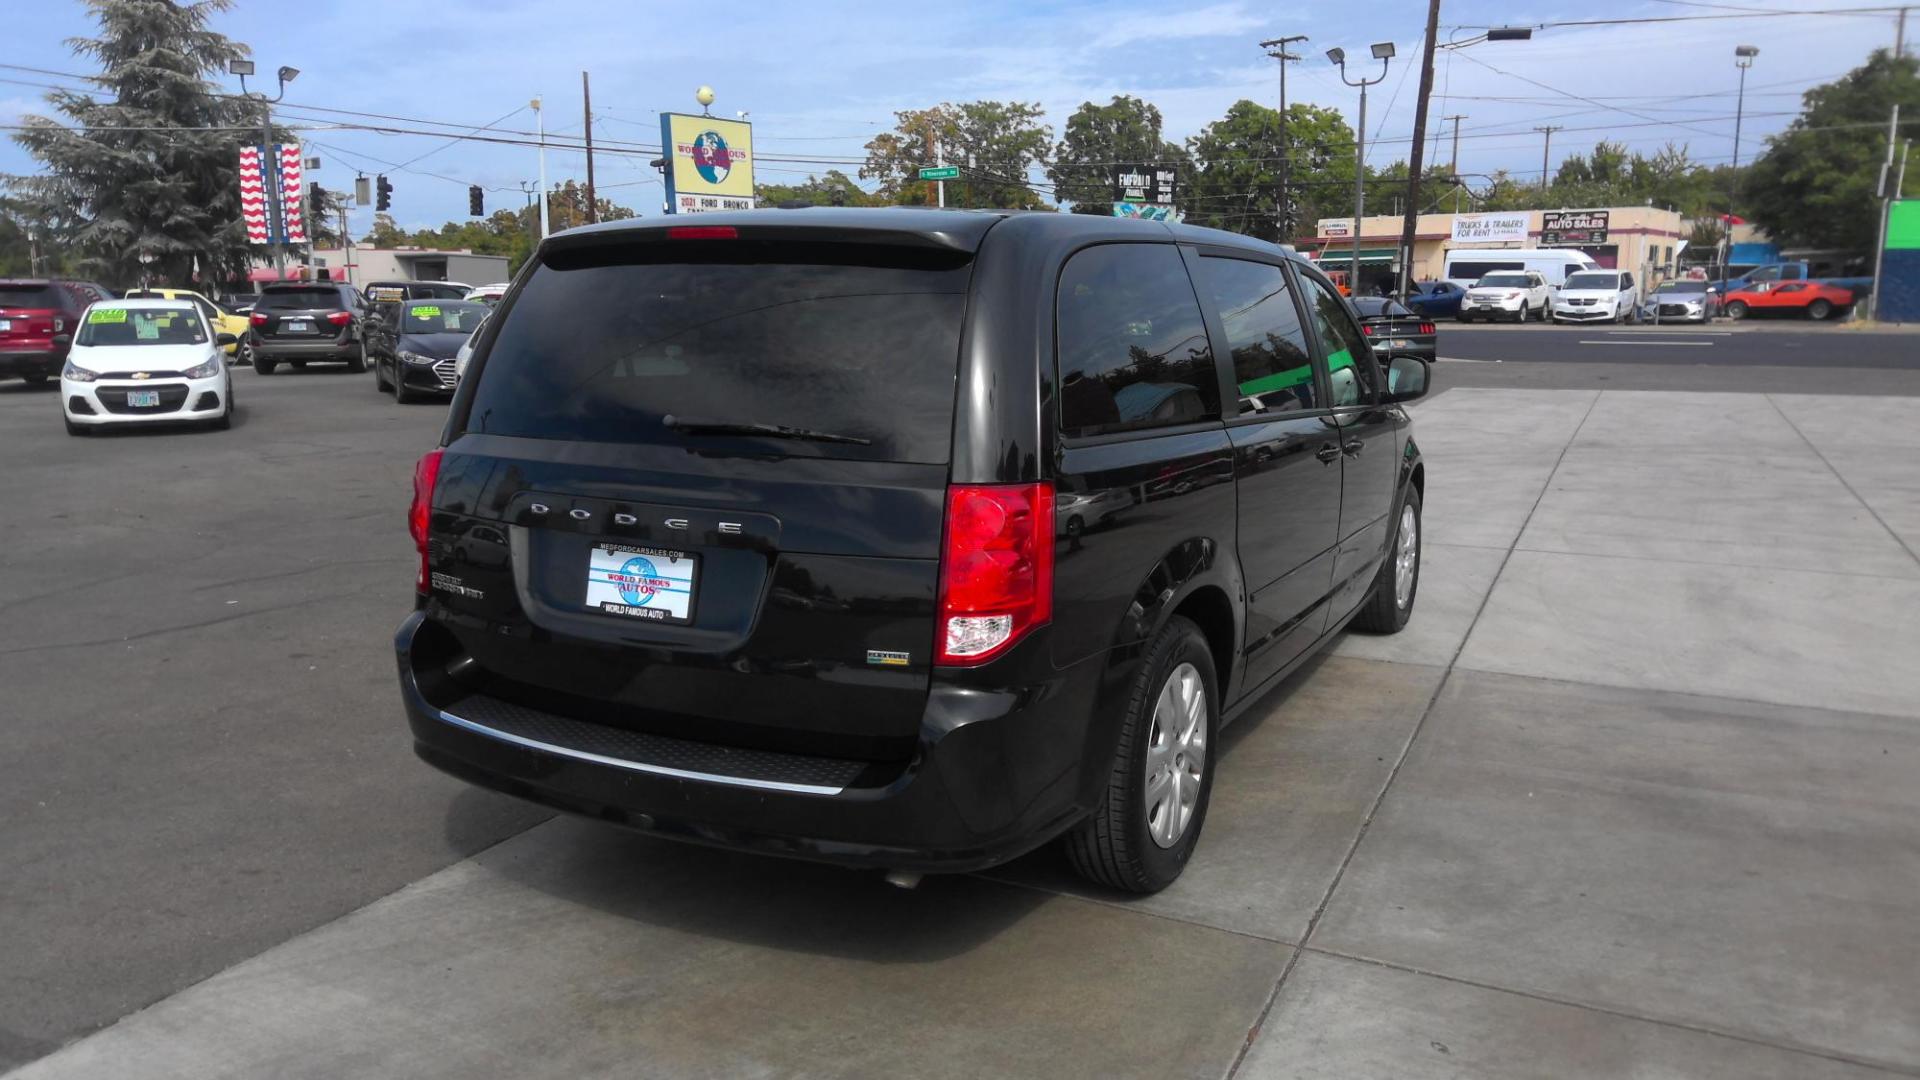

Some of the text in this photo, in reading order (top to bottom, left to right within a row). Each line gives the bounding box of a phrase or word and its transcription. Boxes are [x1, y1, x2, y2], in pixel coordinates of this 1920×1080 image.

[701, 199, 718, 207] FORD
[723, 200, 749, 209] BRONCO
[1457, 221, 1482, 229] TRUCKS
[1493, 219, 1524, 228] TRAILERS
[1547, 219, 1604, 229] AUTO SALES
[531, 503, 742, 535] DODGE
[600, 543, 684, 558] MEDFORDCARSALES.COM
[607, 573, 671, 588] WORLD FAMOUS
[619, 583, 655, 595] AUTOS
[605, 604, 664, 619] WORLD FAMOUS AUTO
